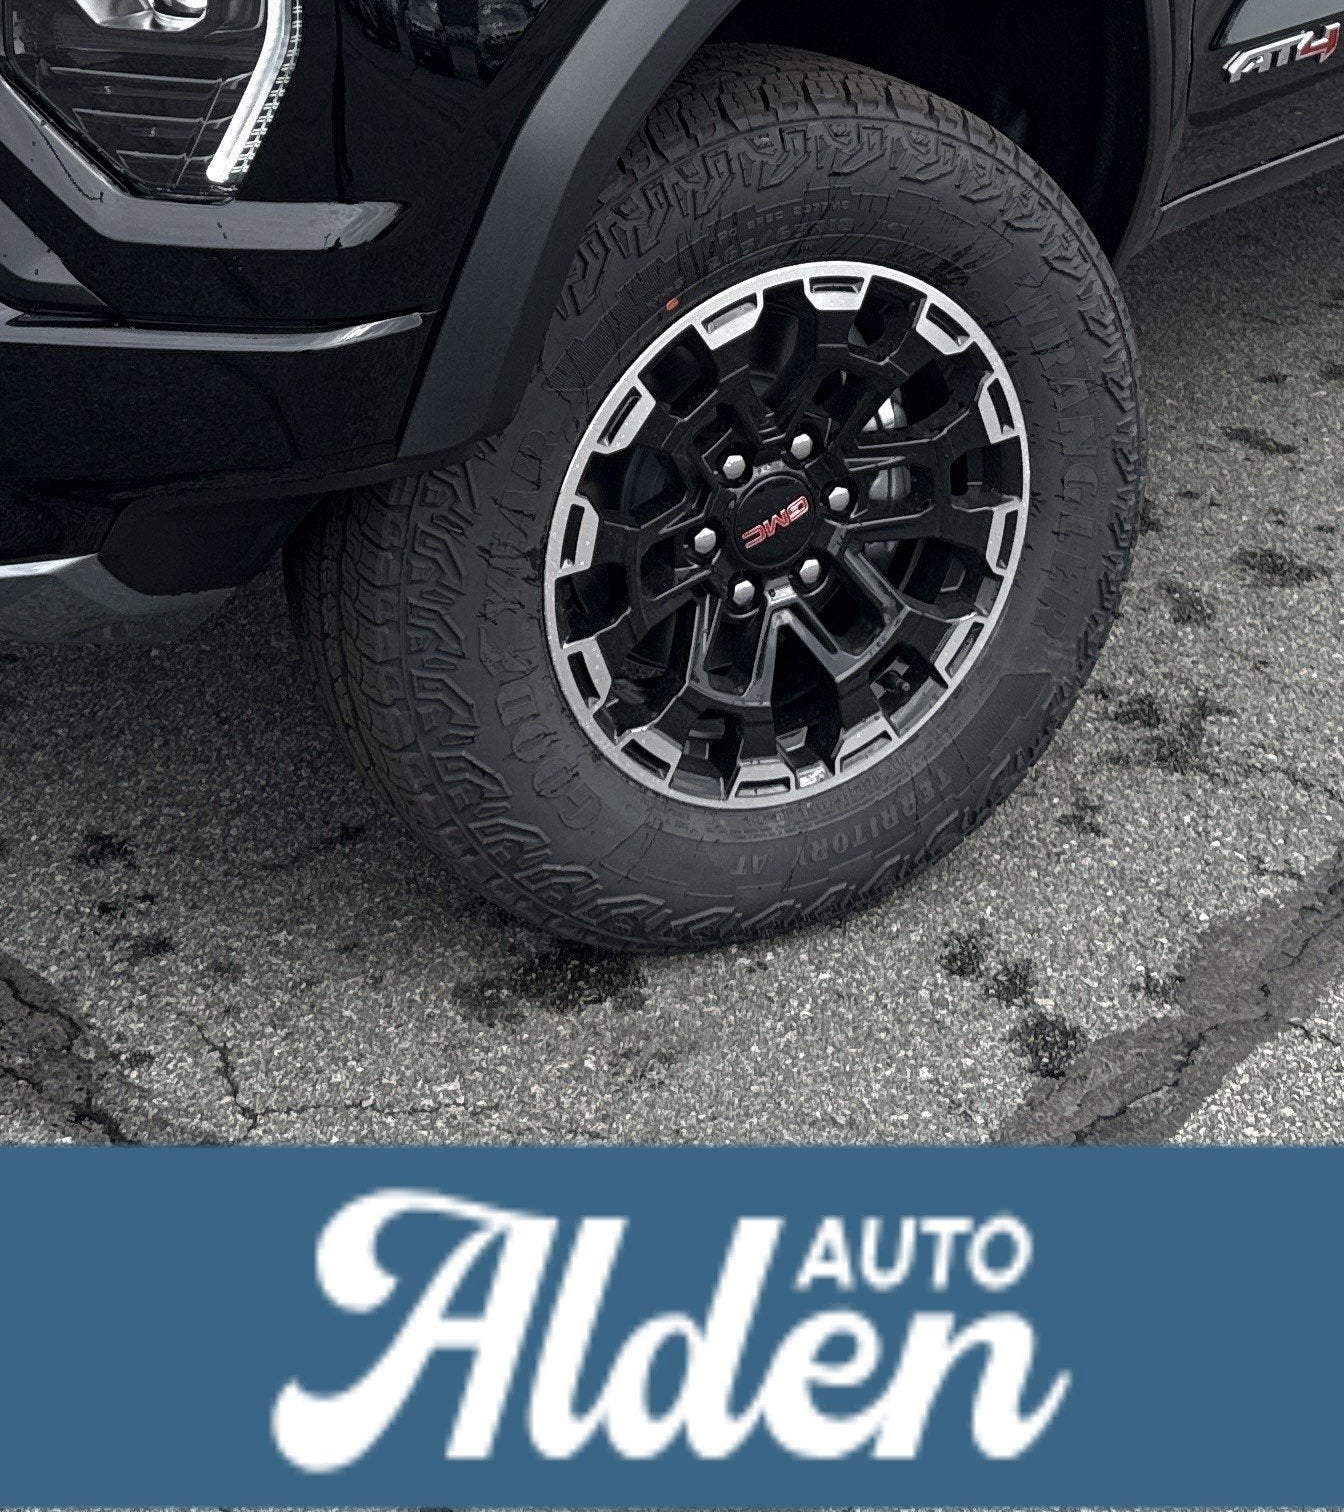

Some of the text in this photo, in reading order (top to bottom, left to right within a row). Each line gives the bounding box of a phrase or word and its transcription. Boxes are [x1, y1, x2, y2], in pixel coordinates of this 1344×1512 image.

[1222, 21, 1342, 85] AT4
[1004, 273, 1099, 638] WRANGLER
[741, 495, 809, 549] GMC
